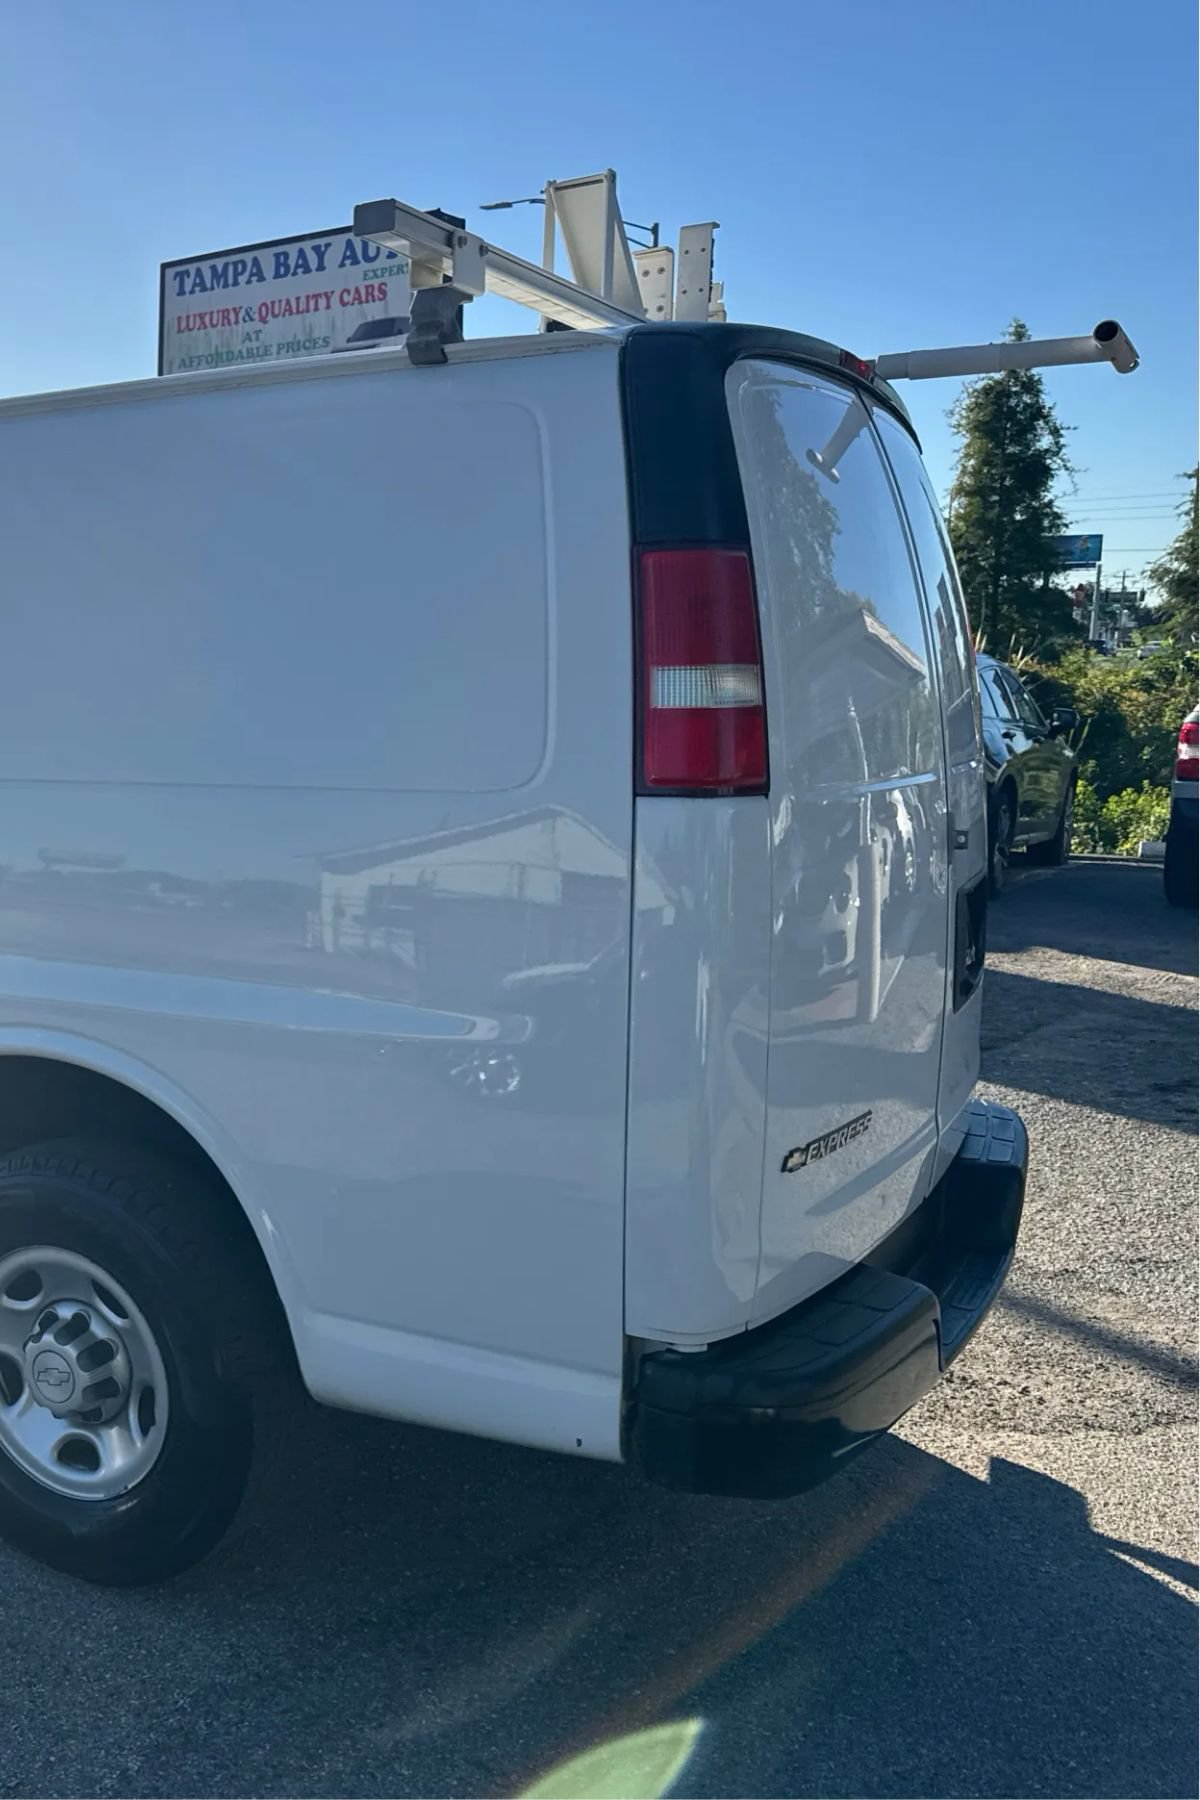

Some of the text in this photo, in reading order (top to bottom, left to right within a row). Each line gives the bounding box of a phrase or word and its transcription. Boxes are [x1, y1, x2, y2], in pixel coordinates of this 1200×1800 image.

[173, 238, 398, 296] TAMPA BAY AU
[338, 282, 388, 308] CARS
[178, 336, 331, 370] AFFORDABLE PRICES
[242, 329, 263, 344] AT
[806, 1113, 872, 1165] EXPRESS
